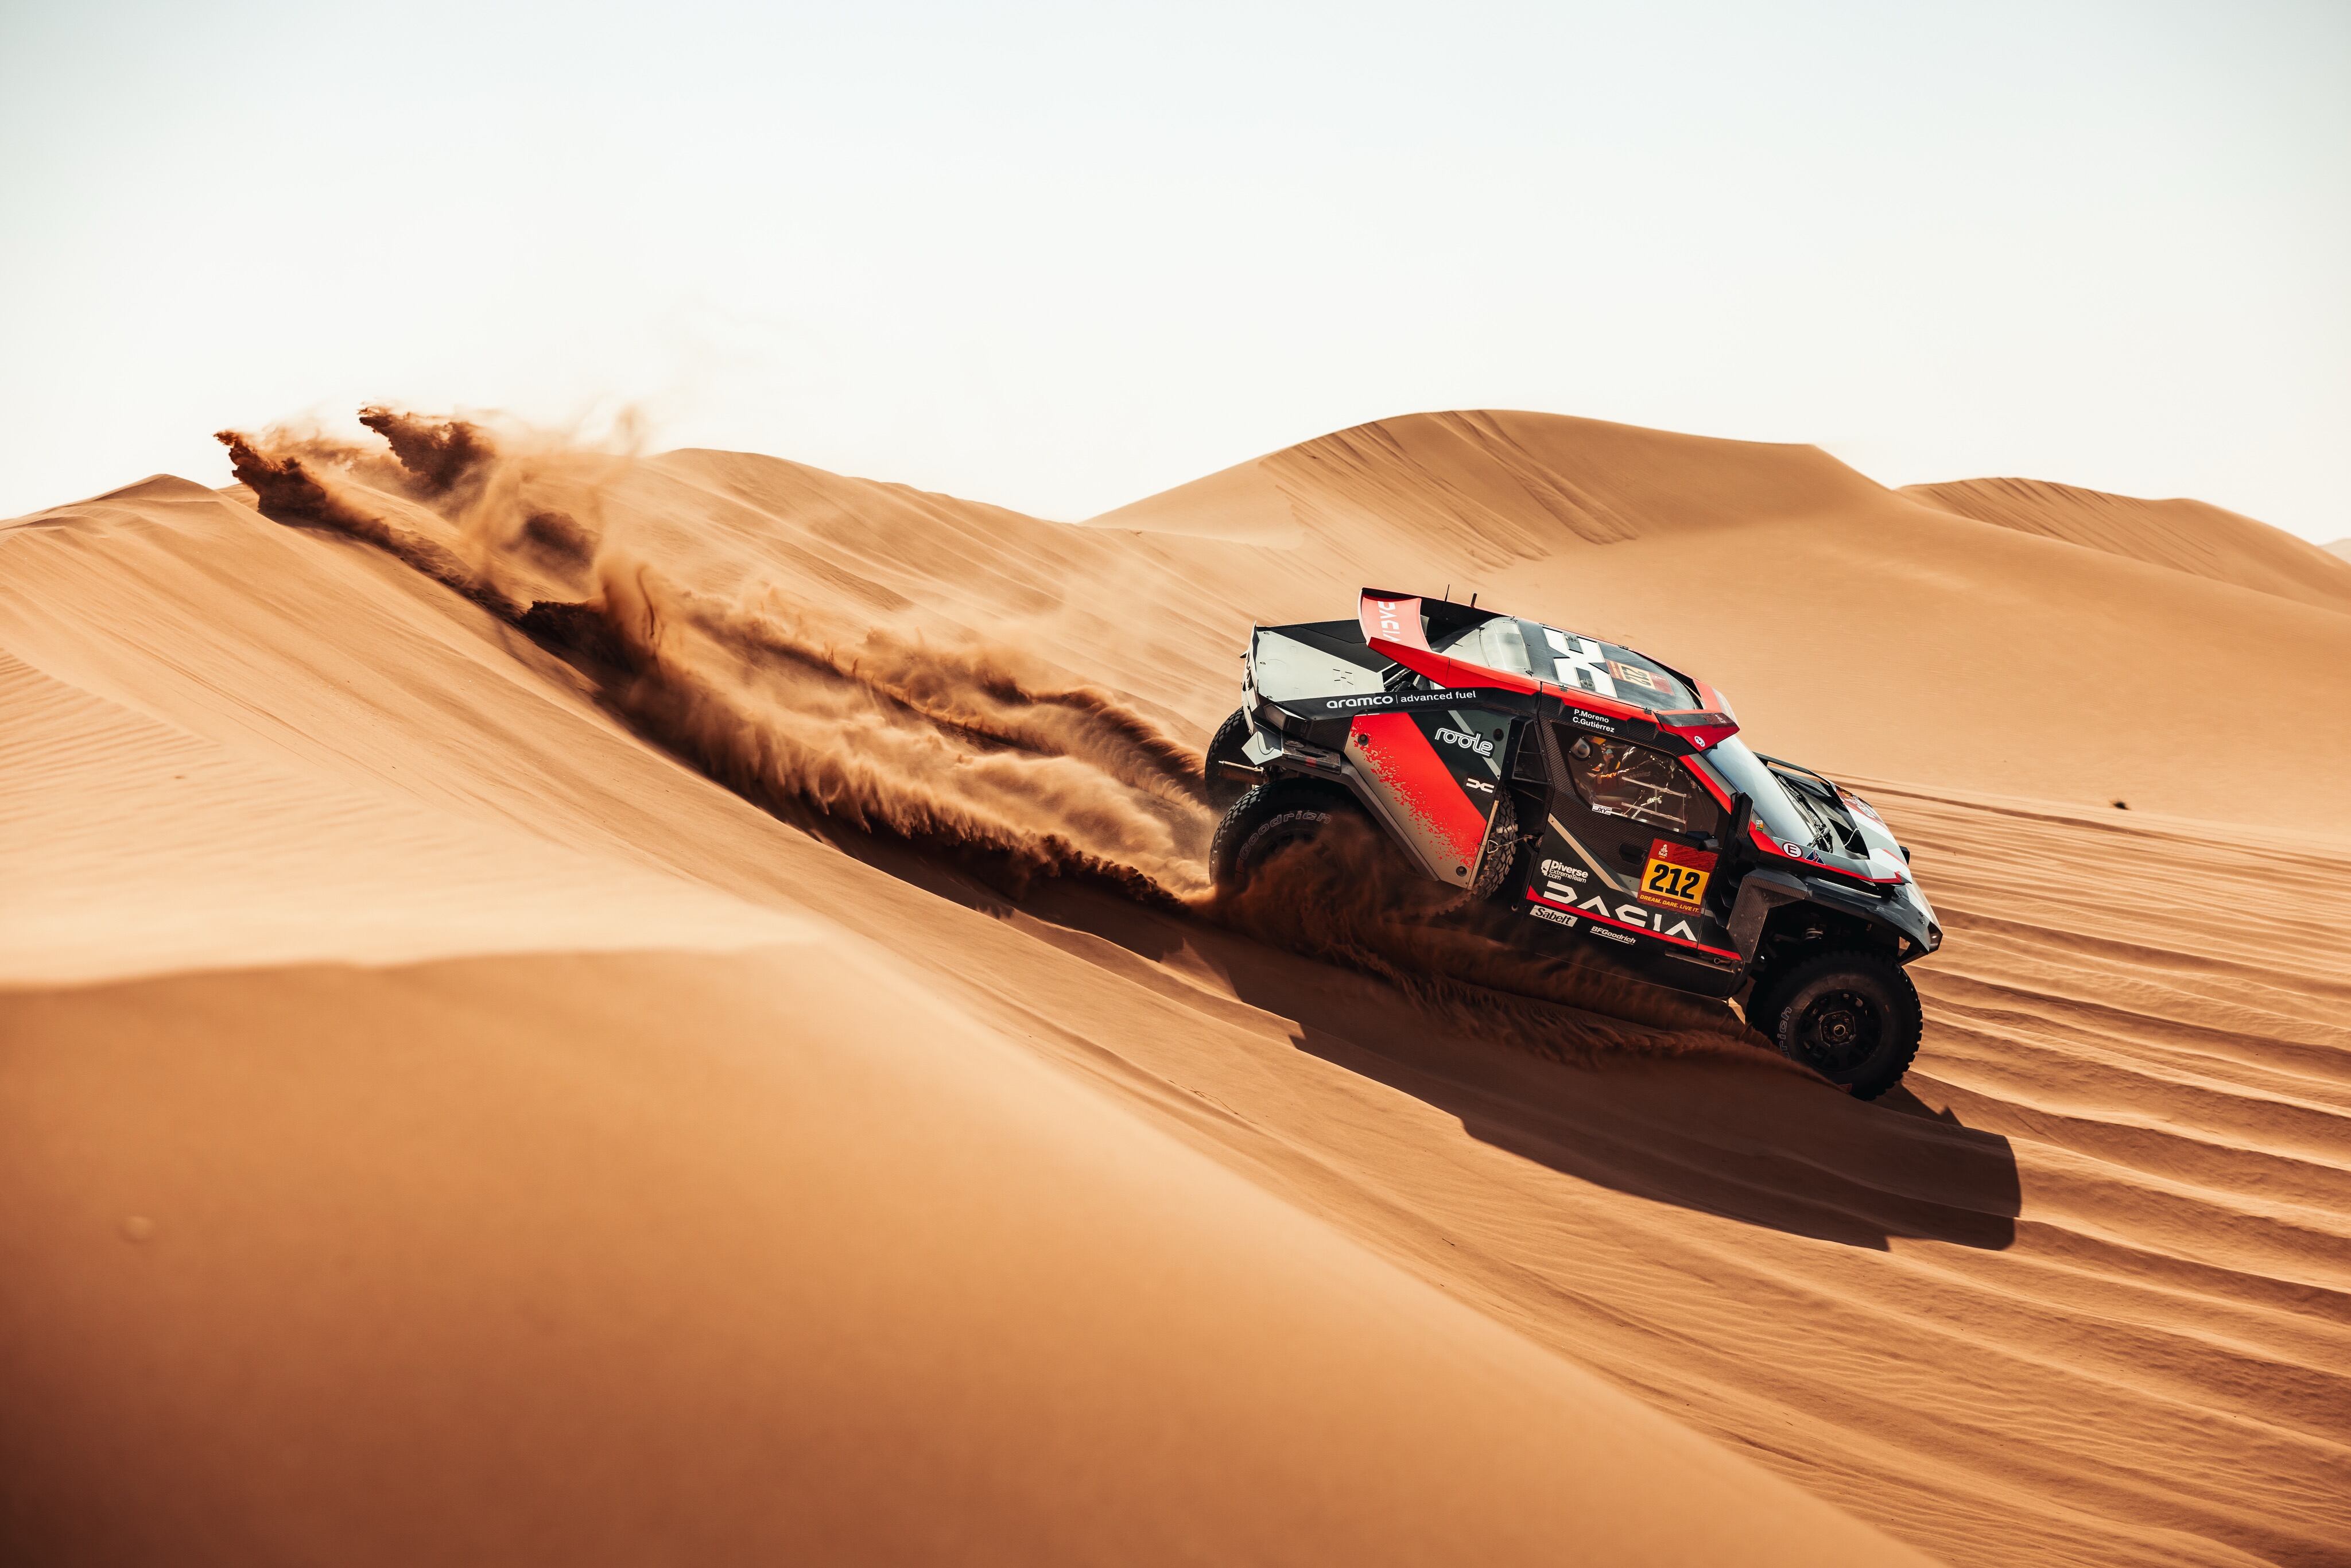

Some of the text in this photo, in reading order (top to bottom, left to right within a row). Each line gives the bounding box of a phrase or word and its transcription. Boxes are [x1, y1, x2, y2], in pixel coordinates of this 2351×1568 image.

[1326, 690, 1476, 709] aramco advanced fuel
[1573, 716, 1615, 733] C.Gutiérrez
[1574, 709, 1609, 723] P.Moreno
[1435, 728, 1493, 756] roole
[1787, 845, 1797, 856] E
[1550, 868, 1586, 883] ExtremeTeam
[1551, 860, 1588, 878] Diverse
[1649, 864, 1700, 900] 212
[1640, 894, 1661, 903] DREAM.
[1662, 900, 1678, 908] DARE.
[1535, 907, 1572, 925] Sabelt
[1543, 880, 1697, 941] DACIA
[1591, 926, 1636, 944] BFGoodrich
